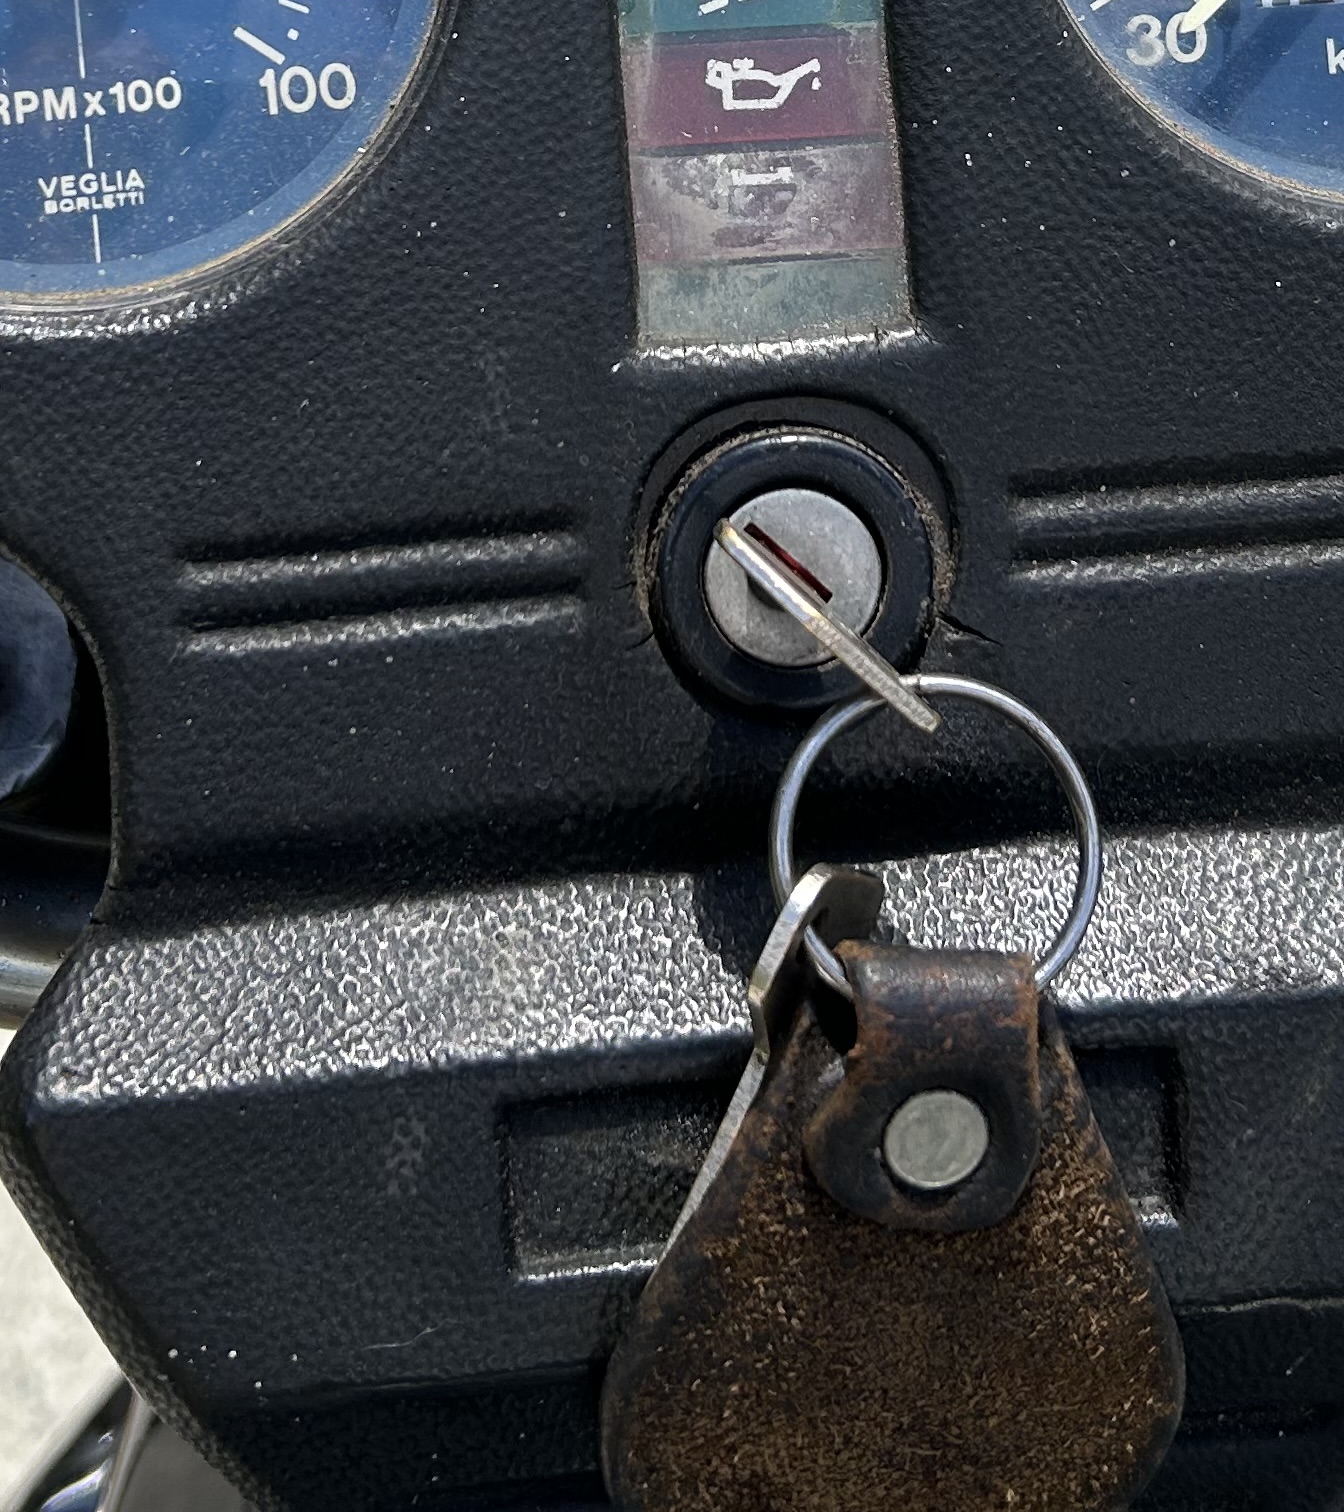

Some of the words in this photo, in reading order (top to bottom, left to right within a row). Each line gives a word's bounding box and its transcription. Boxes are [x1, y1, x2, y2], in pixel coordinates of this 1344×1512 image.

[1125, 10, 1206, 65] 30
[258, 62, 356, 116] 100
[38, 169, 146, 197] VEGLIA
[44, 191, 145, 215] BORLETTI
